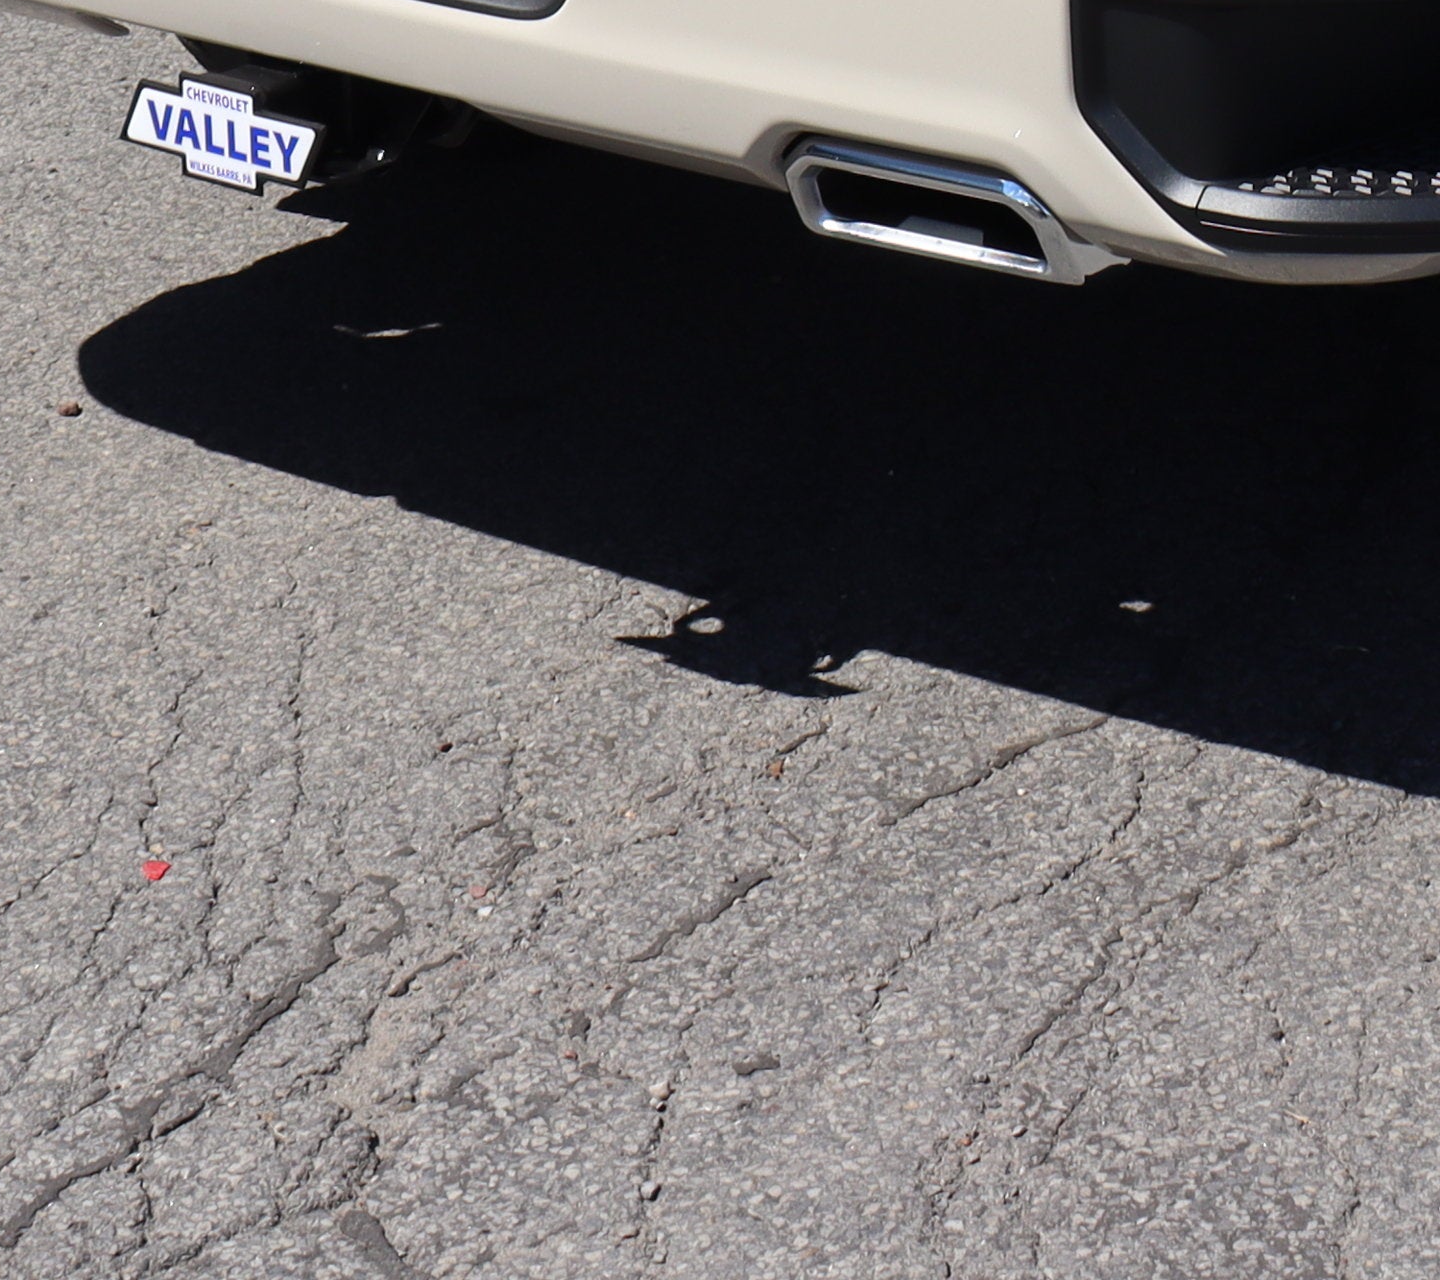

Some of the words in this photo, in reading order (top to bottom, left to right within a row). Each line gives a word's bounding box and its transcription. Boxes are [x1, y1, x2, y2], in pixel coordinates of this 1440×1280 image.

[186, 86, 250, 114] CHEVROLET
[146, 98, 300, 174] VALLEY
[189, 160, 215, 176] WILKES
[242, 173, 254, 186] PA
